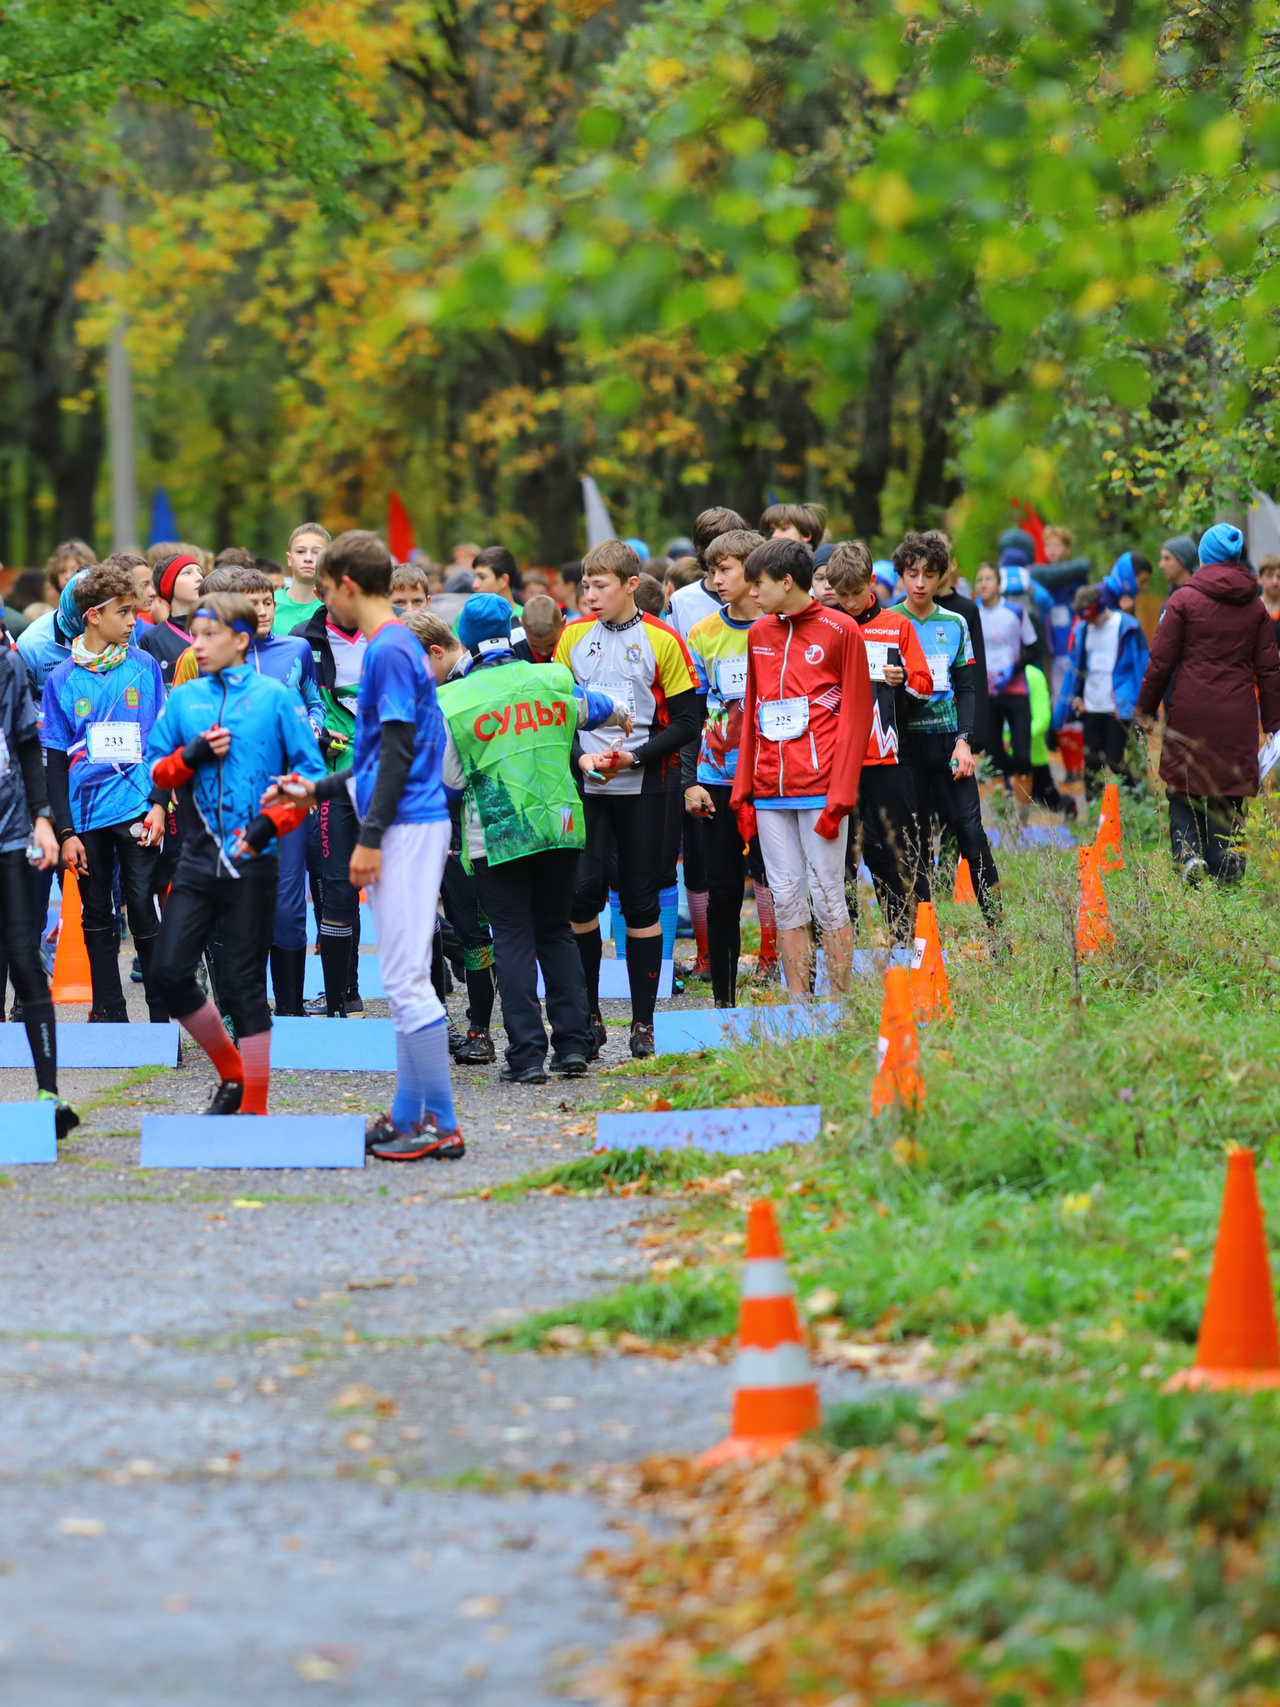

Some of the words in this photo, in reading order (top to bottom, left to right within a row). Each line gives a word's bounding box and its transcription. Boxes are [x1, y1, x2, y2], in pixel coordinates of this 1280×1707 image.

[864, 628, 900, 636] МОСКВА
[473, 700, 567, 742] СУДЬЯ
[775, 715, 792, 726] 225
[104, 736, 124, 747] 233
